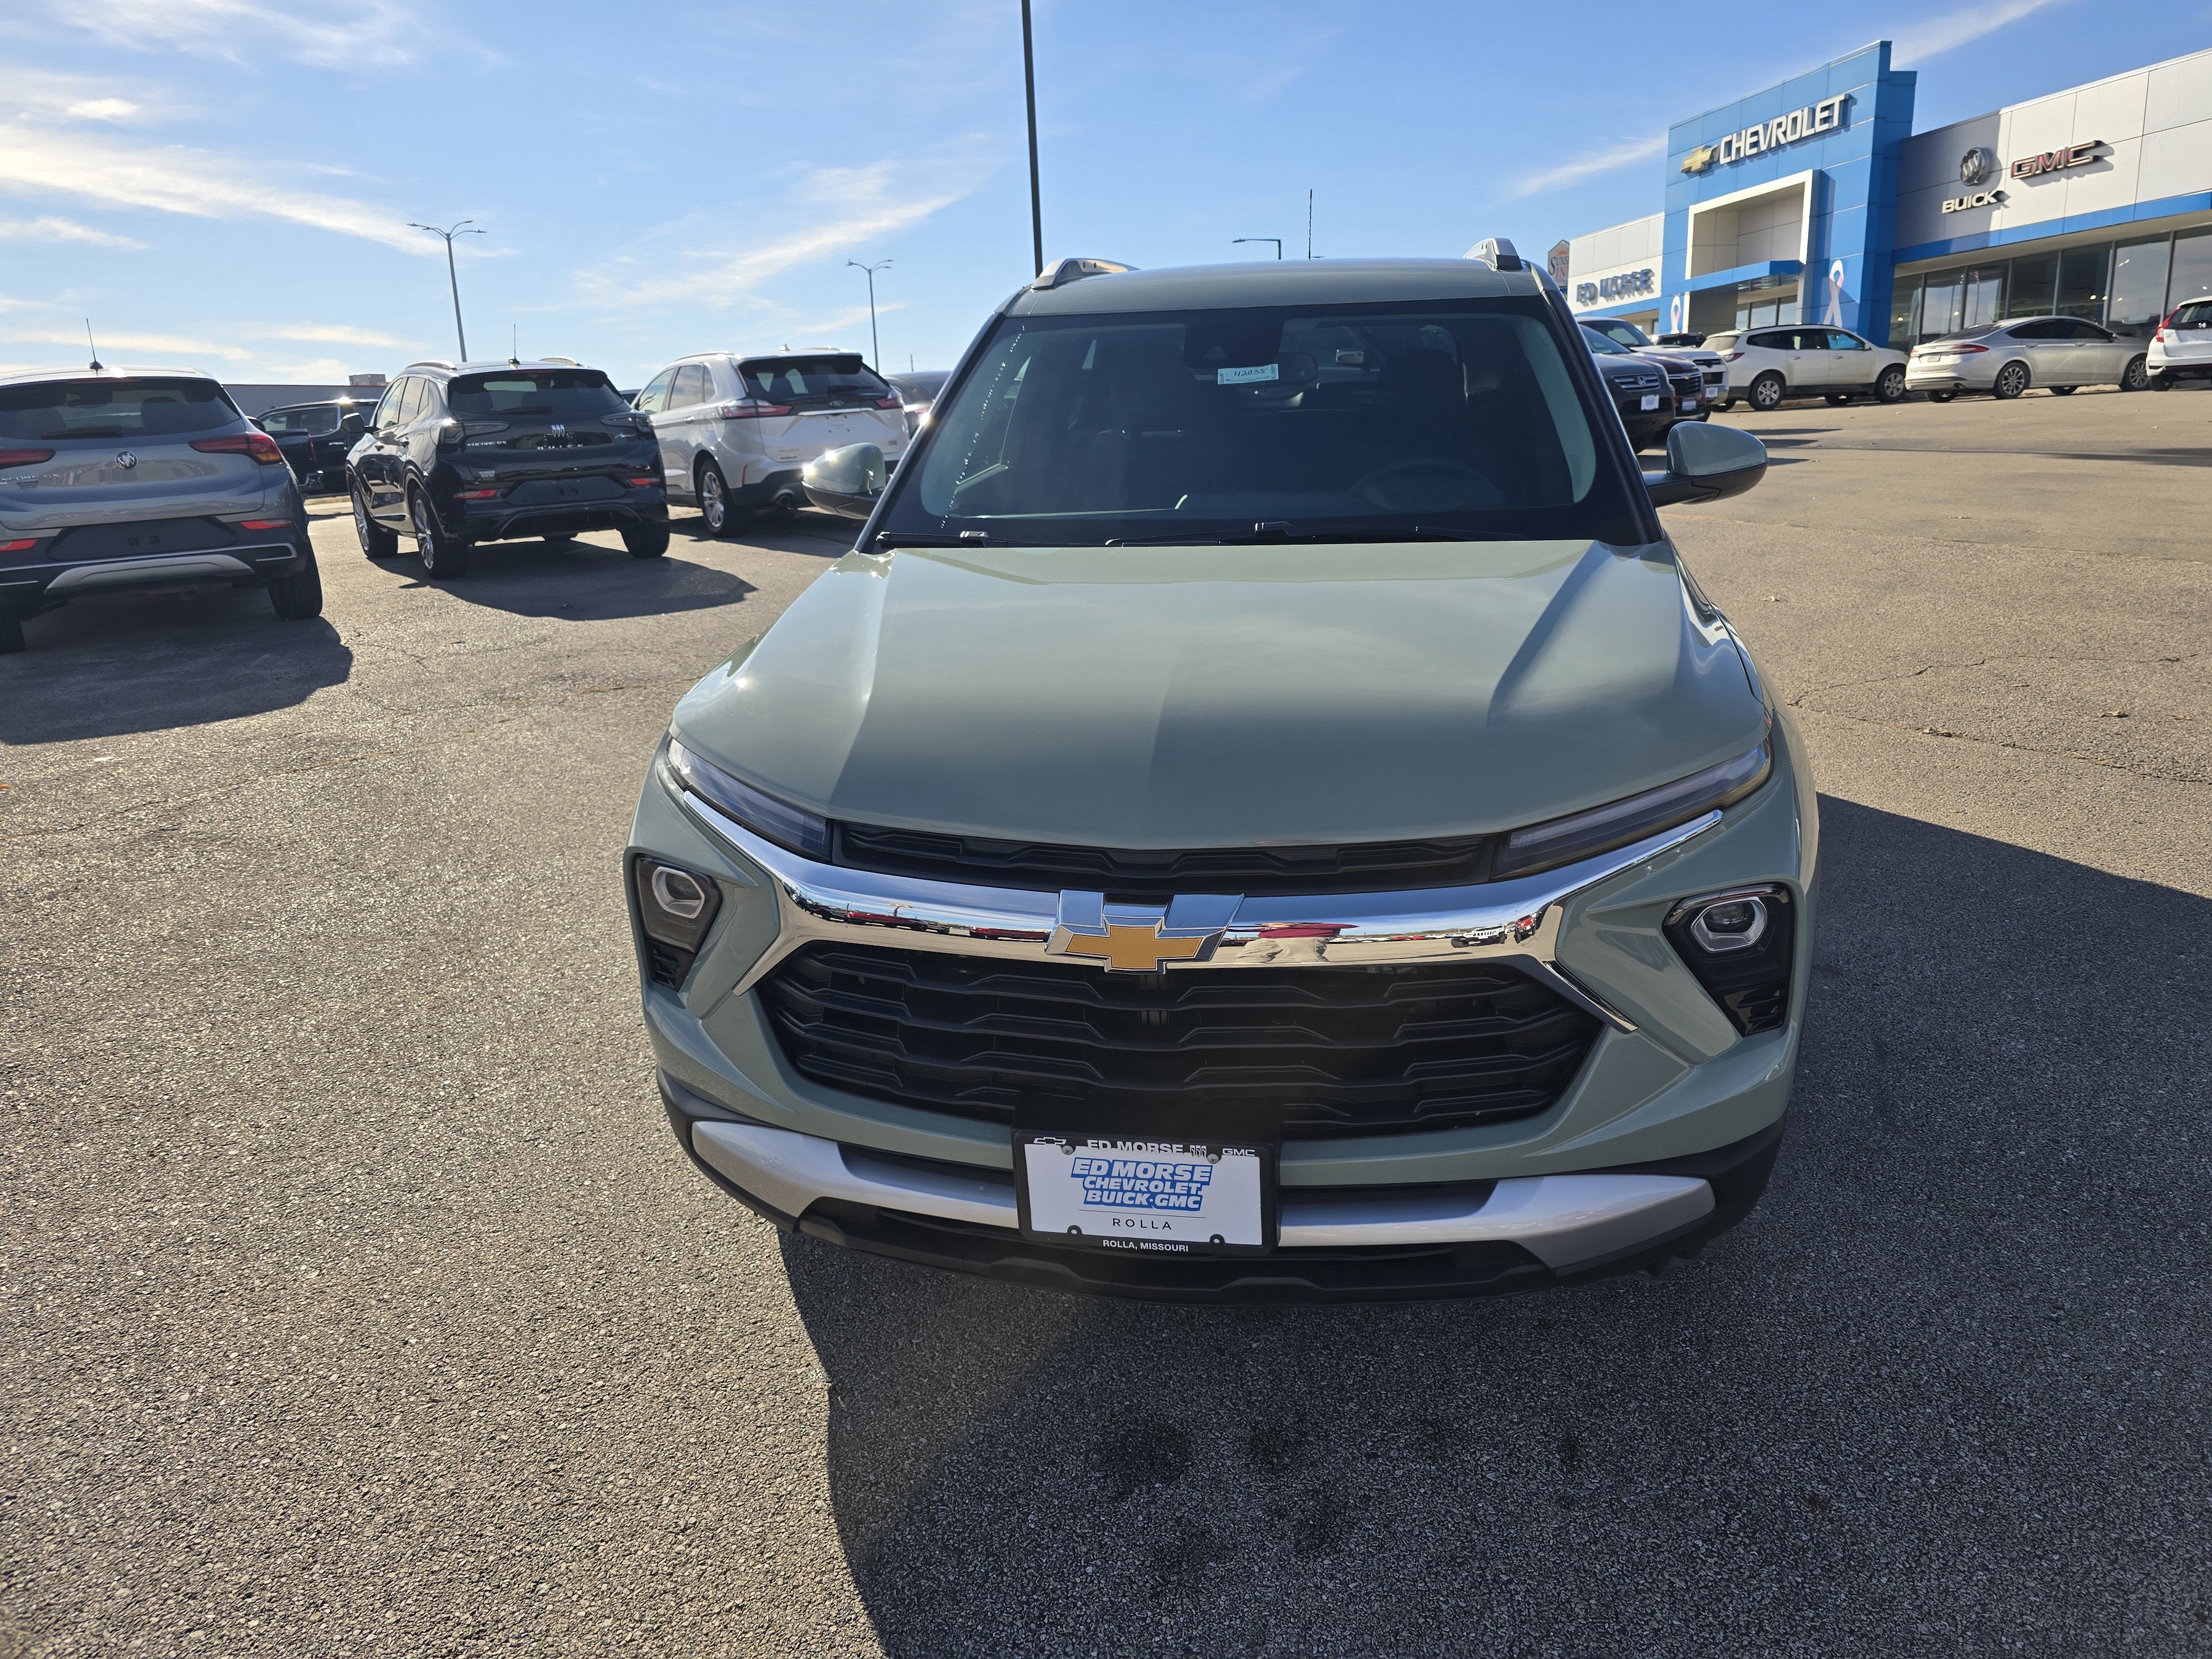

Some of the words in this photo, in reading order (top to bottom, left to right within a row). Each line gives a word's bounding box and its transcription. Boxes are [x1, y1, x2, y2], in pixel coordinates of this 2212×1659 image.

[1719, 93, 1846, 165] CHEVROLET
[2011, 140, 2098, 180] GMC
[1942, 190, 2000, 214] BUICK
[1555, 266, 1569, 279] IN
[1577, 283, 1595, 302] ED
[1600, 269, 1652, 297] MORSE
[1234, 368, 1268, 377] 42038
[1087, 1139, 1112, 1150] ED
[1117, 1141, 1183, 1155] MORSE
[1222, 1148, 1255, 1157] GMC
[1073, 1159, 1109, 1176] ED
[1112, 1161, 1212, 1182] MORSE
[1084, 1176, 1201, 1195] CHEVROLET
[1113, 1218, 1172, 1230] ROLLA
[1103, 1240, 1138, 1250] ROLLA,
[1140, 1242, 1188, 1253] MISSOURI
